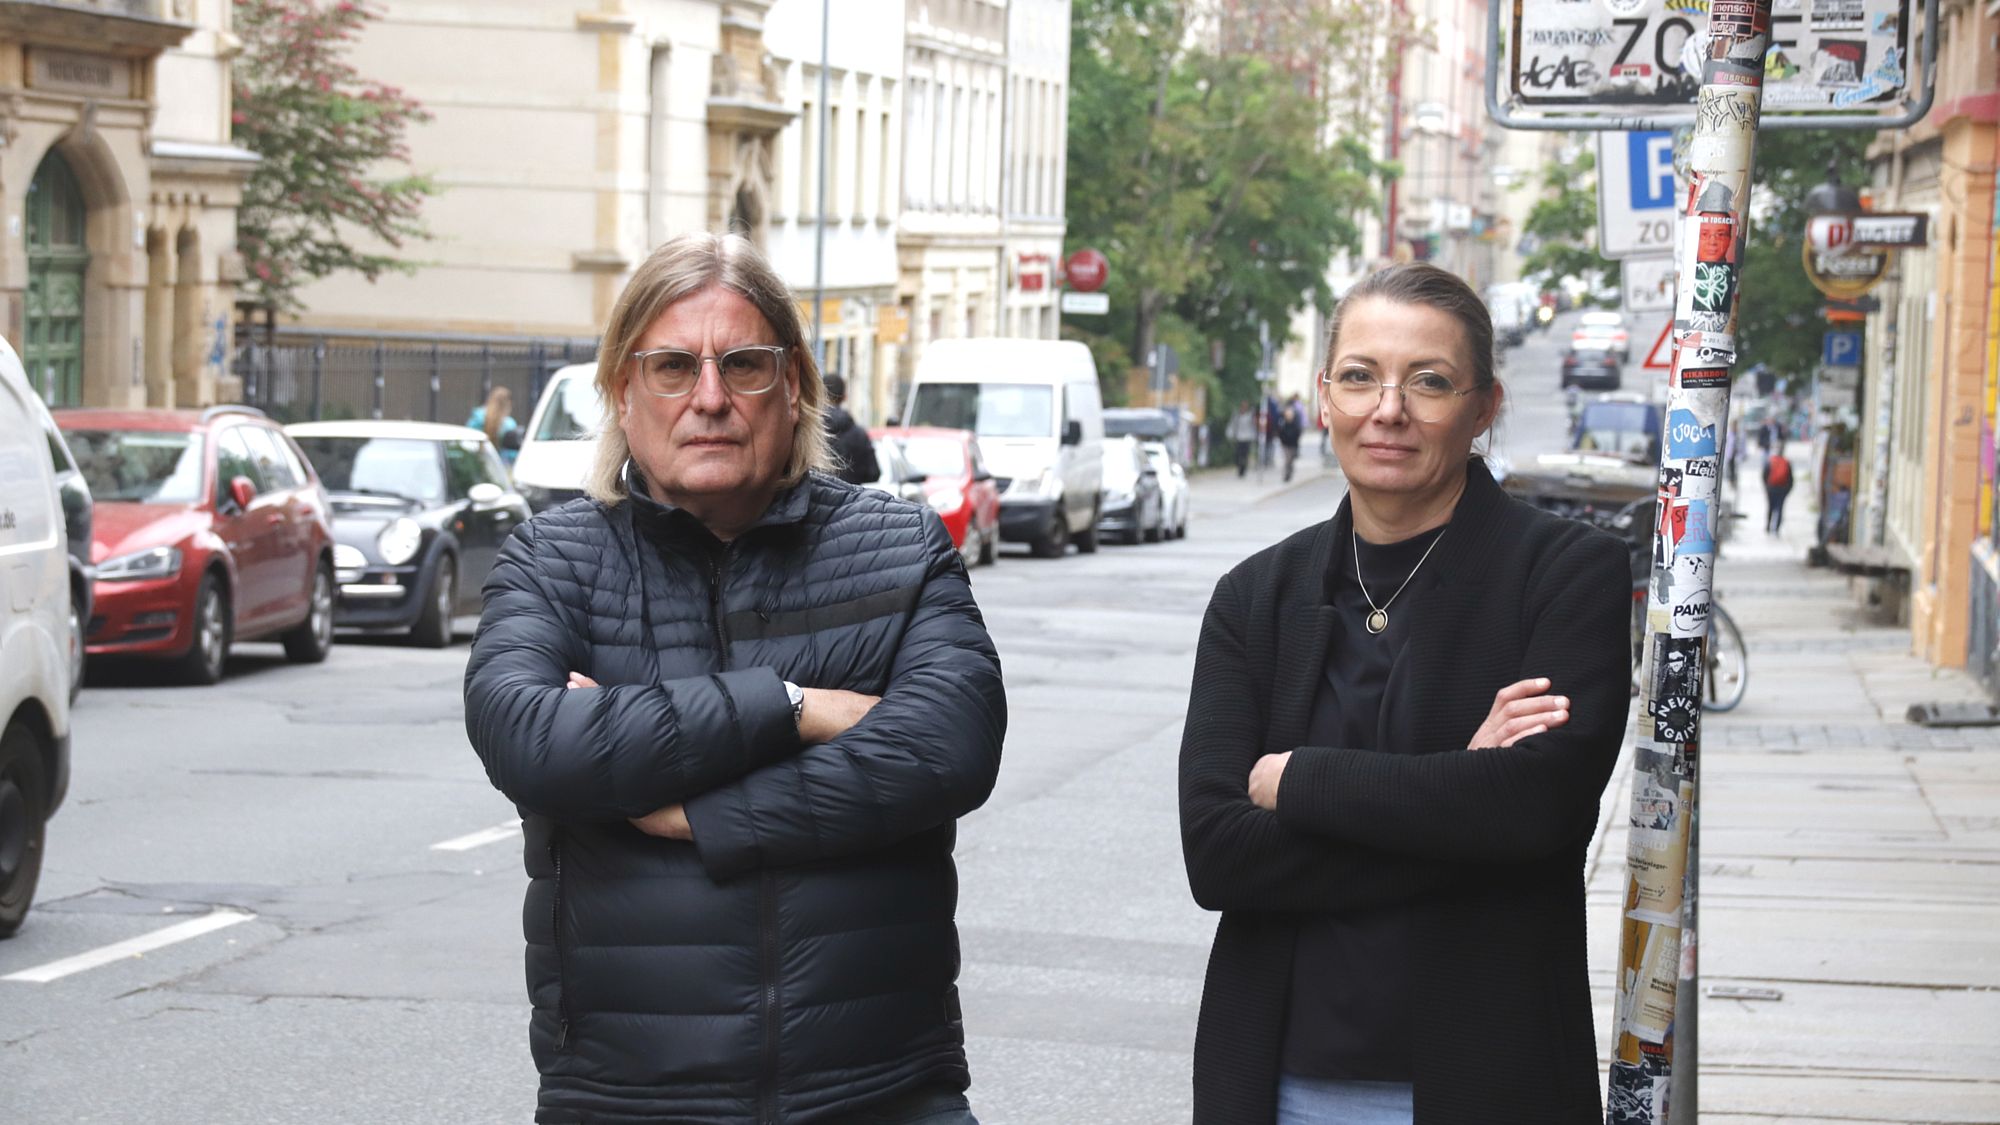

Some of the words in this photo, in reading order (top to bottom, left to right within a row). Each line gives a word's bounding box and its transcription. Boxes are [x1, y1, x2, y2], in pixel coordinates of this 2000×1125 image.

[1713, 4, 1753, 14] mensch
[1613, 16, 1802, 79] ZOE
[1831, 337, 1854, 364] P
[1658, 697, 1697, 718] NEVER
[1657, 721, 1696, 742] AGAIN
